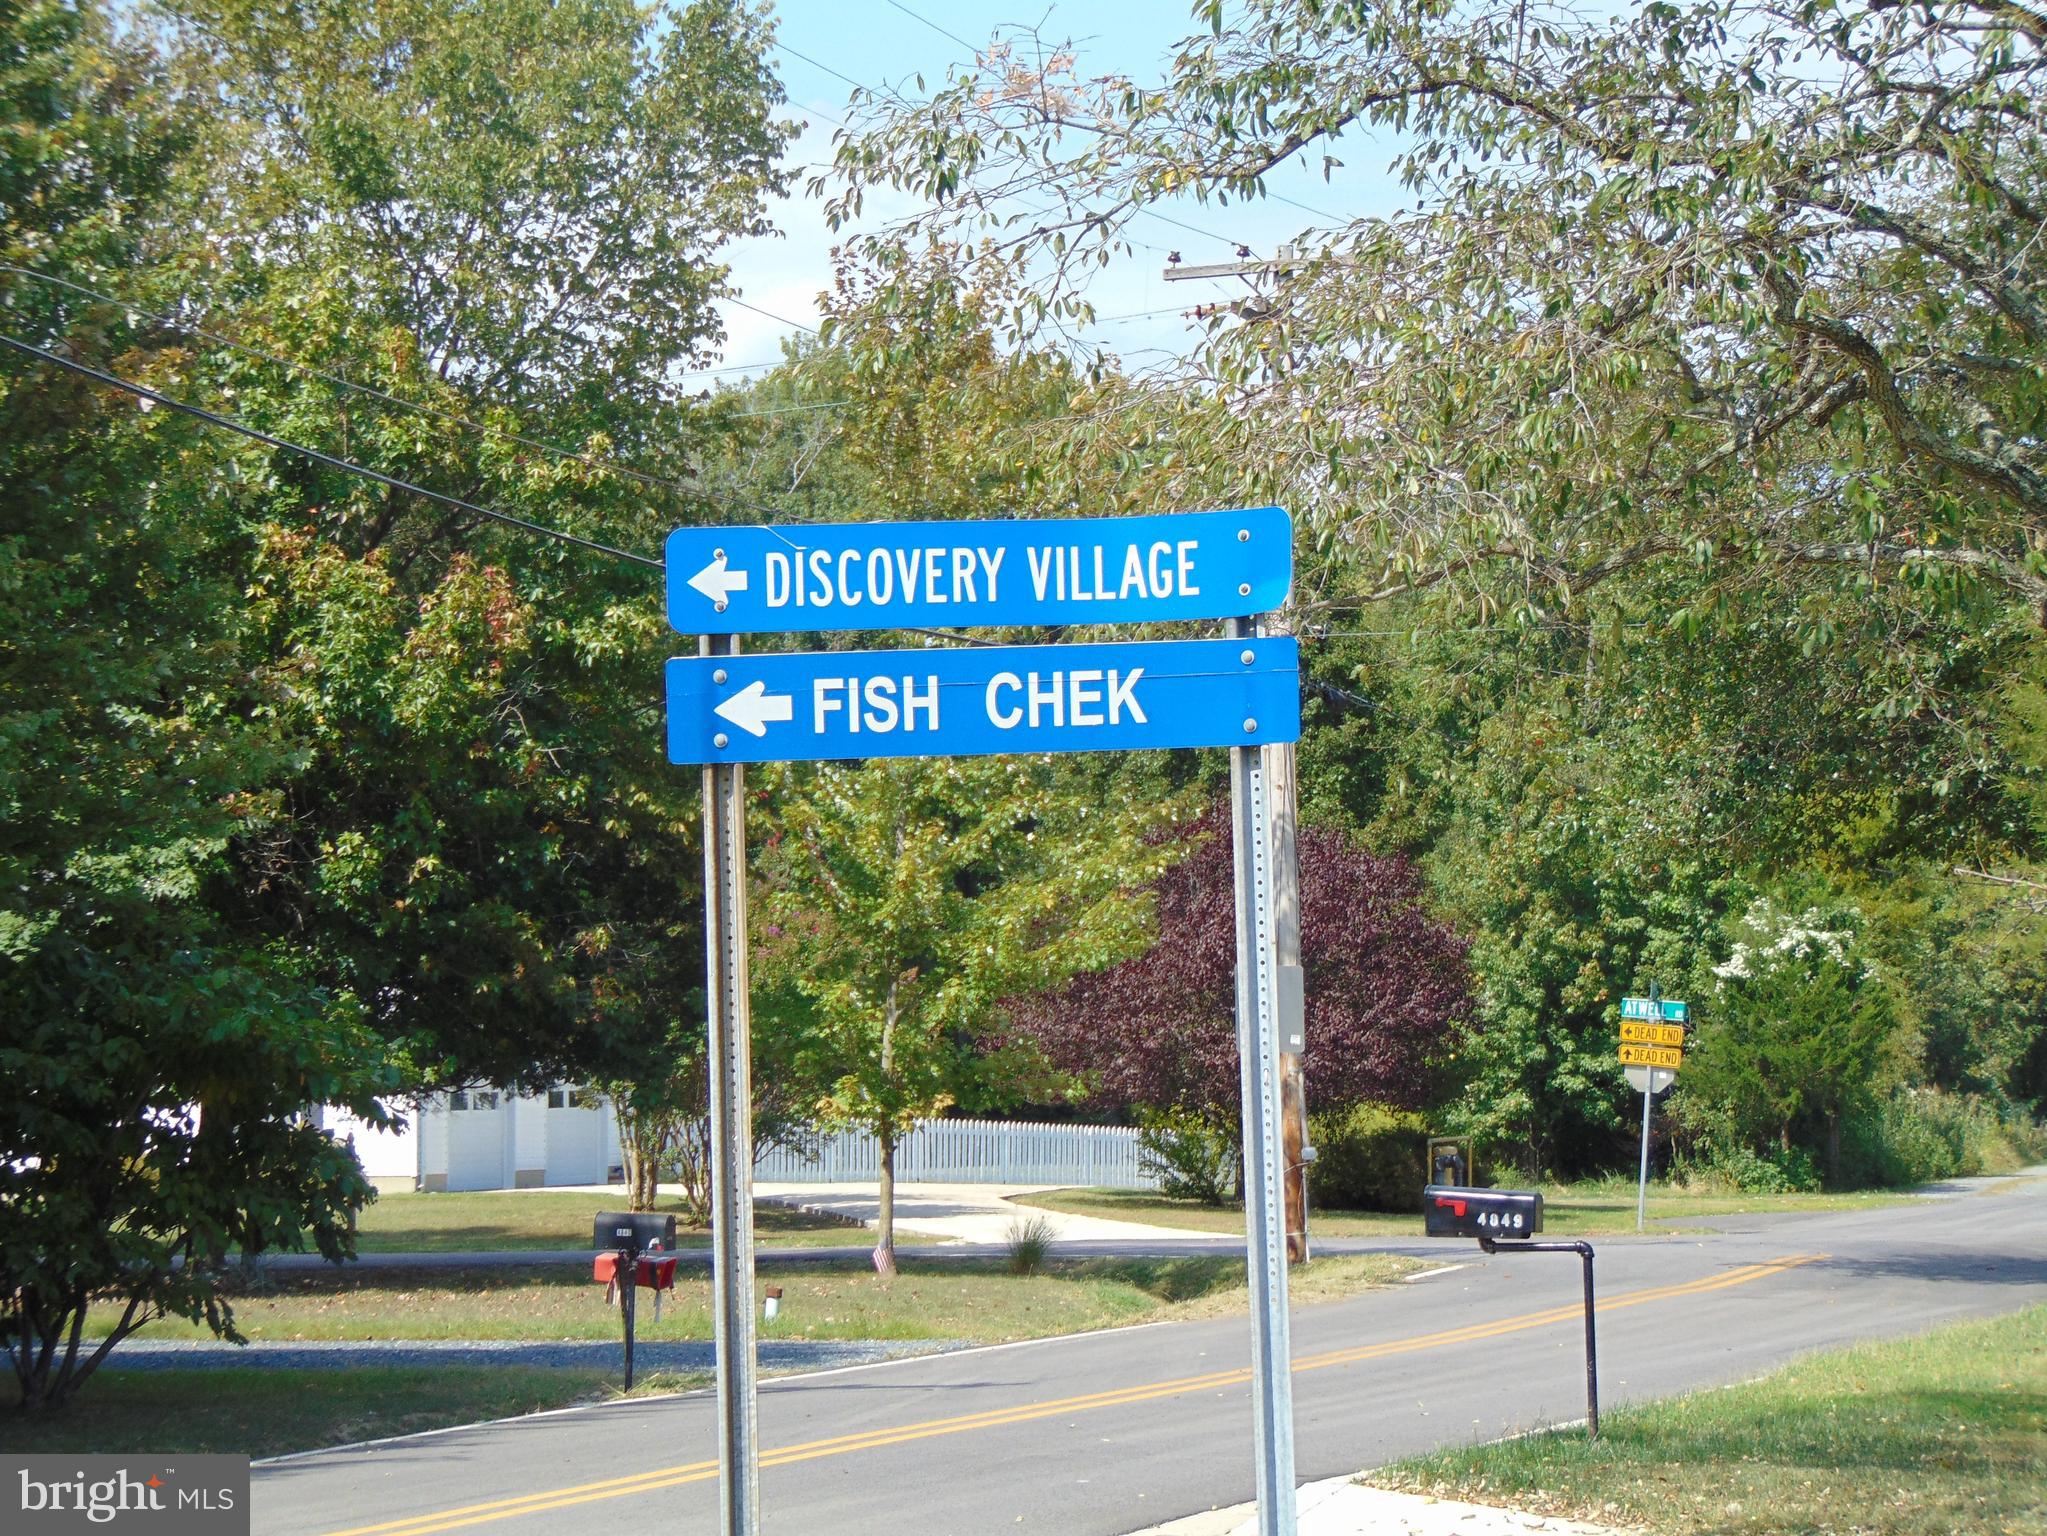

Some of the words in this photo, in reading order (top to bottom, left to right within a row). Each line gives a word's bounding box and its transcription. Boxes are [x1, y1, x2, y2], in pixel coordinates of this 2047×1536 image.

[765, 548, 1006, 607] DISCOVERY
[1027, 541, 1199, 601] VILLAGE
[813, 675, 939, 733] FISH
[986, 668, 1147, 728] CHEK
[1625, 1001, 1667, 1017] ATWELL
[1634, 1027, 1657, 1040] DEAD
[1662, 1029, 1679, 1042] END
[1634, 1049, 1657, 1062] DEAD
[1660, 1052, 1677, 1064] END
